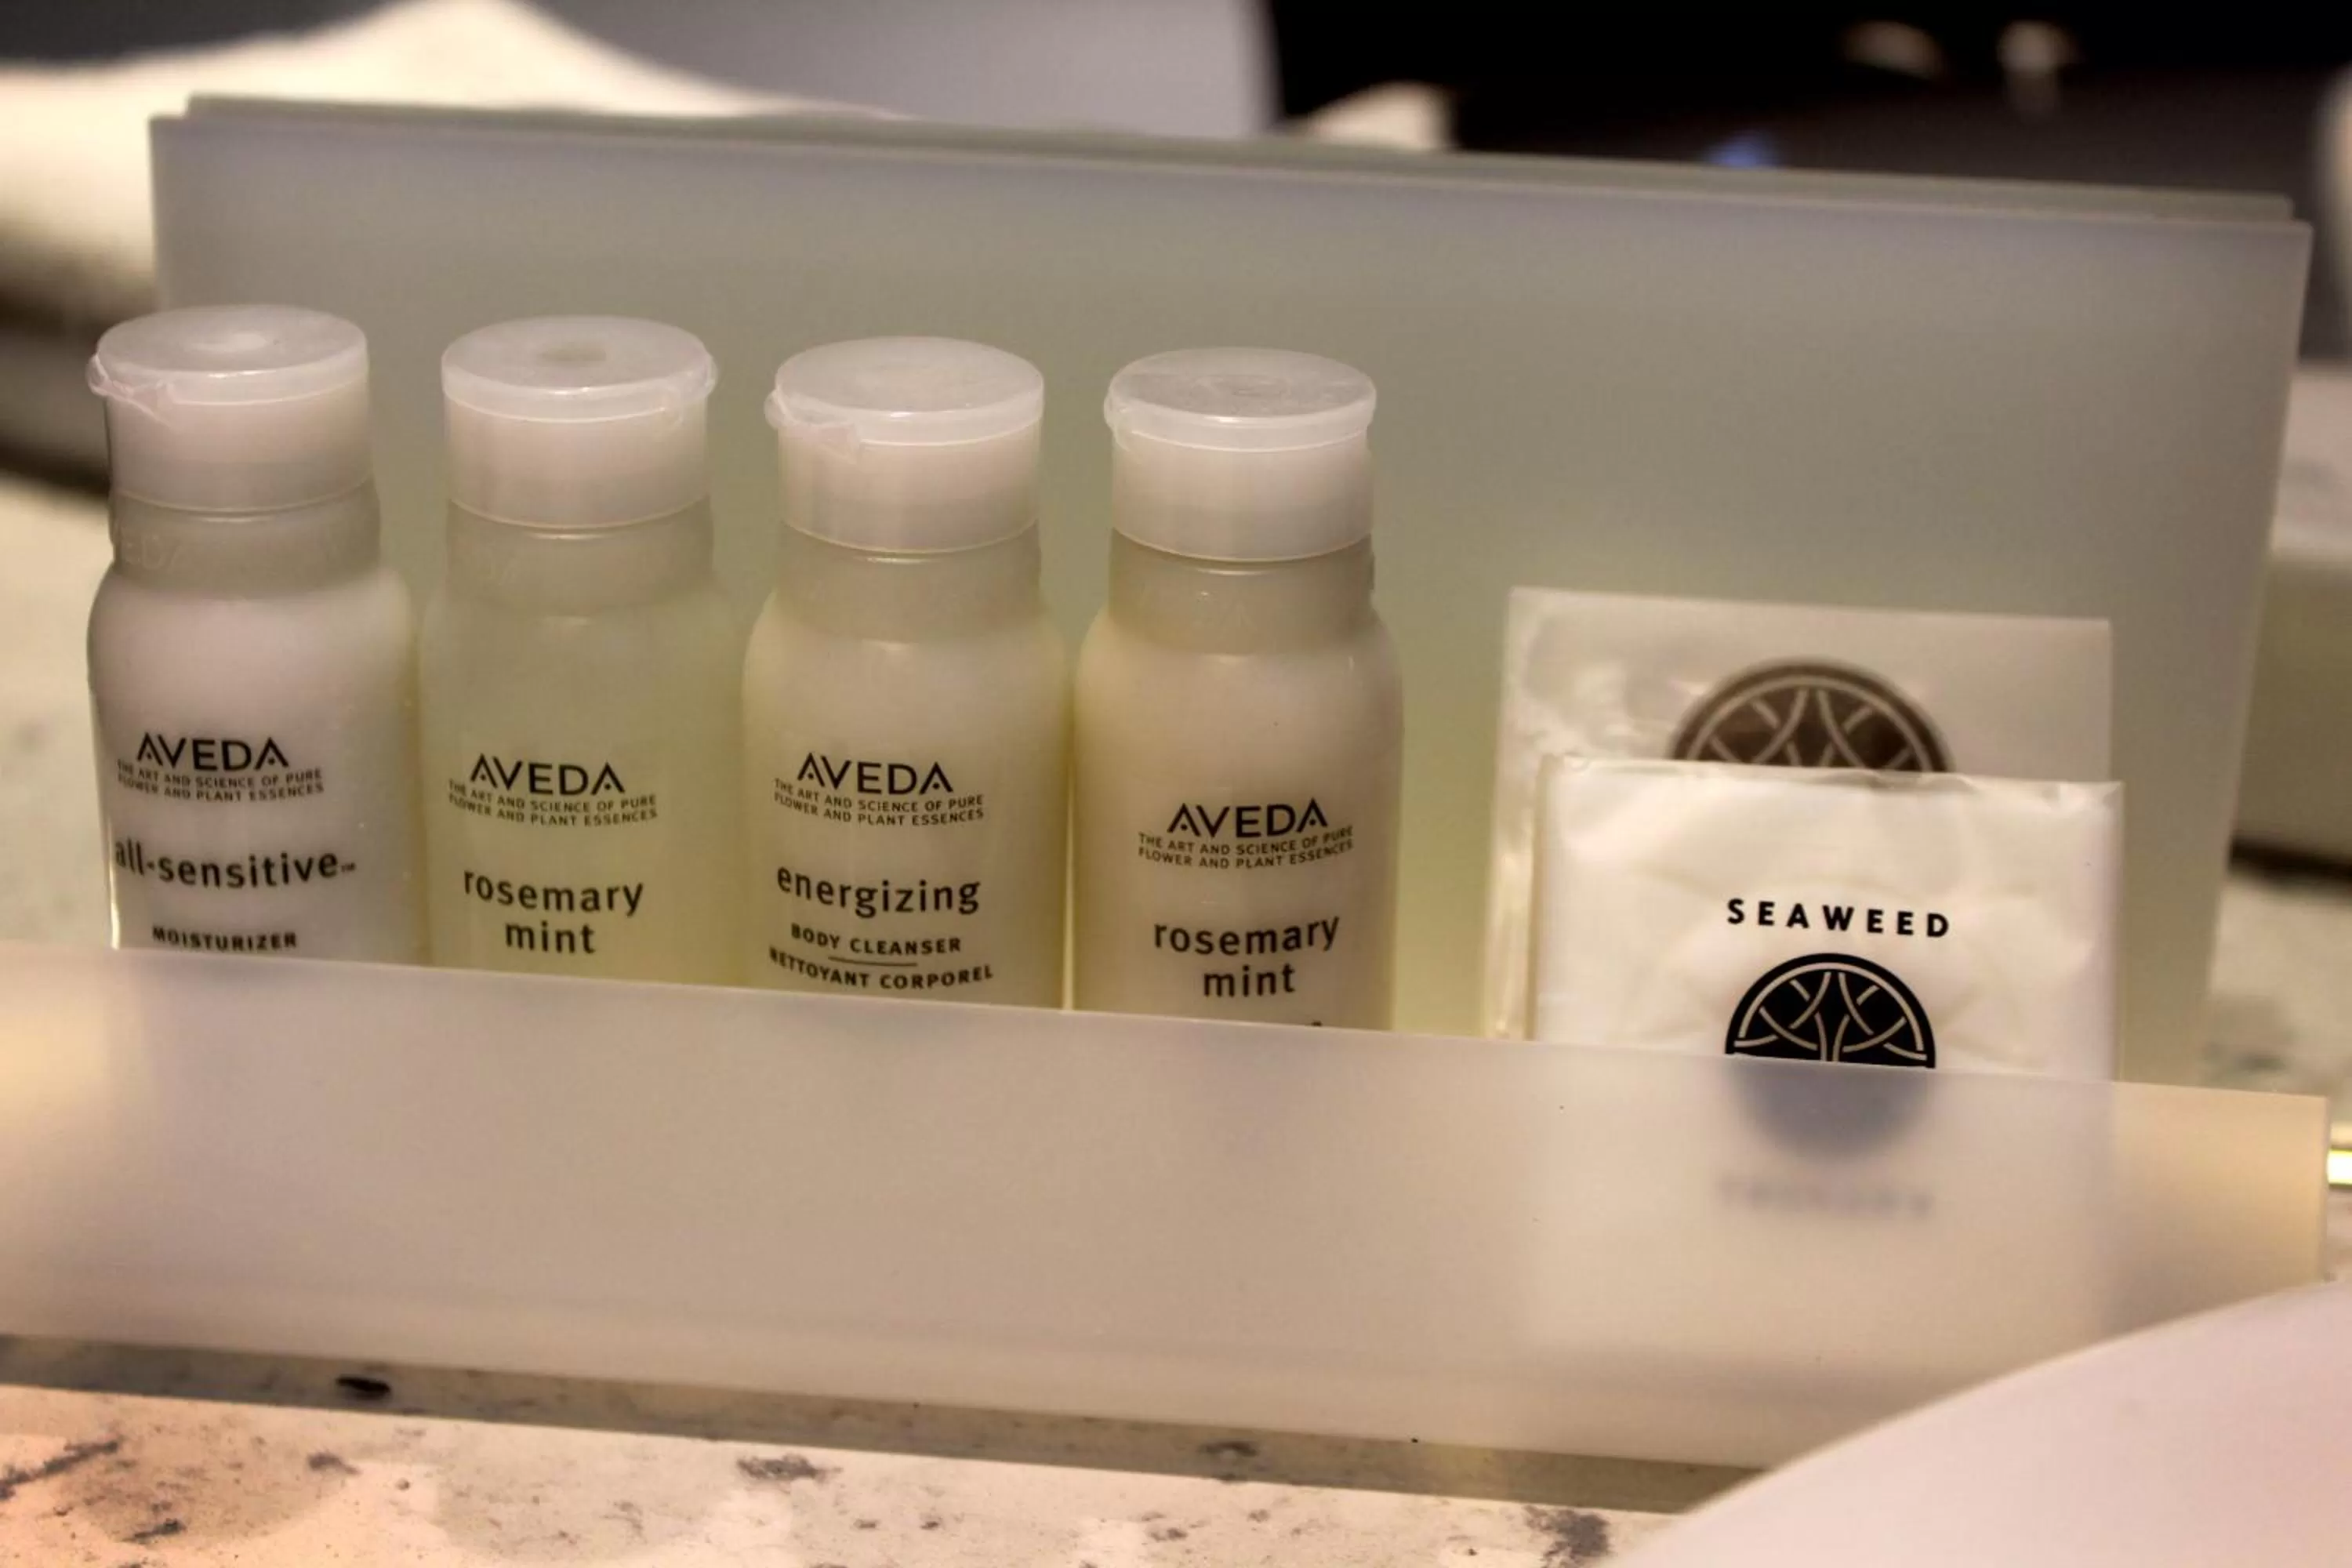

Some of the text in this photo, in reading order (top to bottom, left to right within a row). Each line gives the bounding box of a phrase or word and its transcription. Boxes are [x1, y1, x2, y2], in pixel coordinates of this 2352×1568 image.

[136, 731, 289, 771] AVEDA
[138, 768, 158, 782] ART
[164, 774, 191, 786] AND
[195, 776, 254, 789] SCIENCE
[261, 774, 278, 786] OF
[286, 768, 322, 782] PURE
[470, 753, 625, 796] AVEDA
[797, 752, 953, 796] AVEDA
[164, 786, 191, 800] AND
[196, 789, 241, 802] PLANT
[249, 782, 325, 802] ESSENCES
[448, 793, 658, 826] FLOWER AND PLANT ESSENCES
[449, 779, 656, 813] THE ART AND SCIENCE OF PURE
[774, 791, 984, 826] FLOWER AND PLANT ESSENCES
[775, 778, 983, 813] THE ART AND SCIENCE OF PURE
[1167, 797, 1328, 838] AVEDA
[1138, 826, 1354, 856] THE ART AND SCIENCE OF PURE
[1138, 839, 1354, 869] FLOWER AND PLANT ESSENCES
[463, 869, 644, 918] rosemary
[776, 866, 981, 920] energizing
[1726, 898, 1950, 938] SEAWEED
[152, 926, 297, 951] MOISTURIZER
[505, 920, 597, 954] mint
[791, 922, 962, 956] BODY CLEANSER
[1153, 916, 1340, 956] rosemary
[769, 945, 994, 990] NETTOYANT CORPOREL
[1203, 963, 1295, 999] mint
